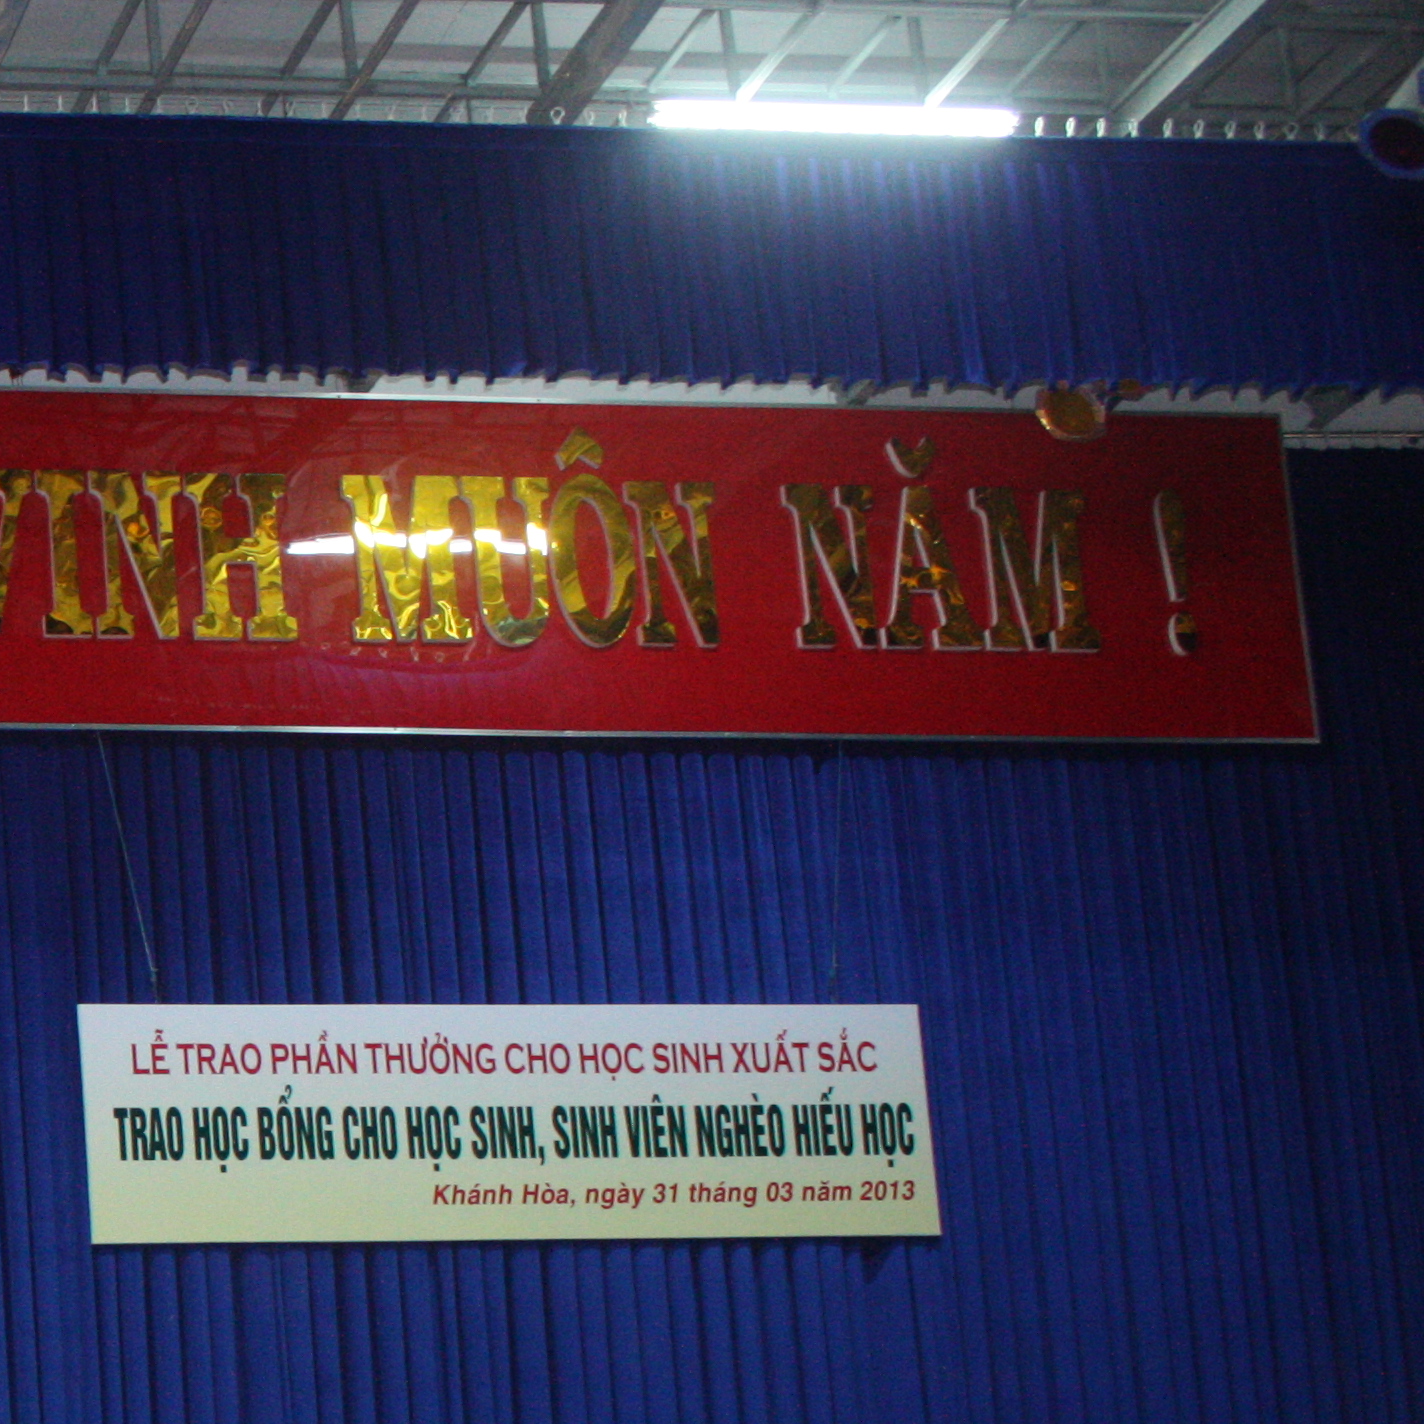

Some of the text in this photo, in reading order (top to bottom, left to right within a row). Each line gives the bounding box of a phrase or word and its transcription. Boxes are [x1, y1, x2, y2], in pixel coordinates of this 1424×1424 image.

[341, 428, 720, 650] MUÔN
[780, 436, 1102, 652] NĂM
[1152, 488, 1198, 658] !
[131, 1027, 878, 1081] LỄ TRAO PHẦN THƯỞNG CHO HỌC SINH XUẤT SẮC
[113, 1084, 915, 1173] TRAO HỌC BỔNG CHO HỌC SINH, SINH VIÊN NGHÈO HIẾU HỌC
[433, 1179, 916, 1209] Khánh Hòa, ngày 31 tháng 03 năm 2013
